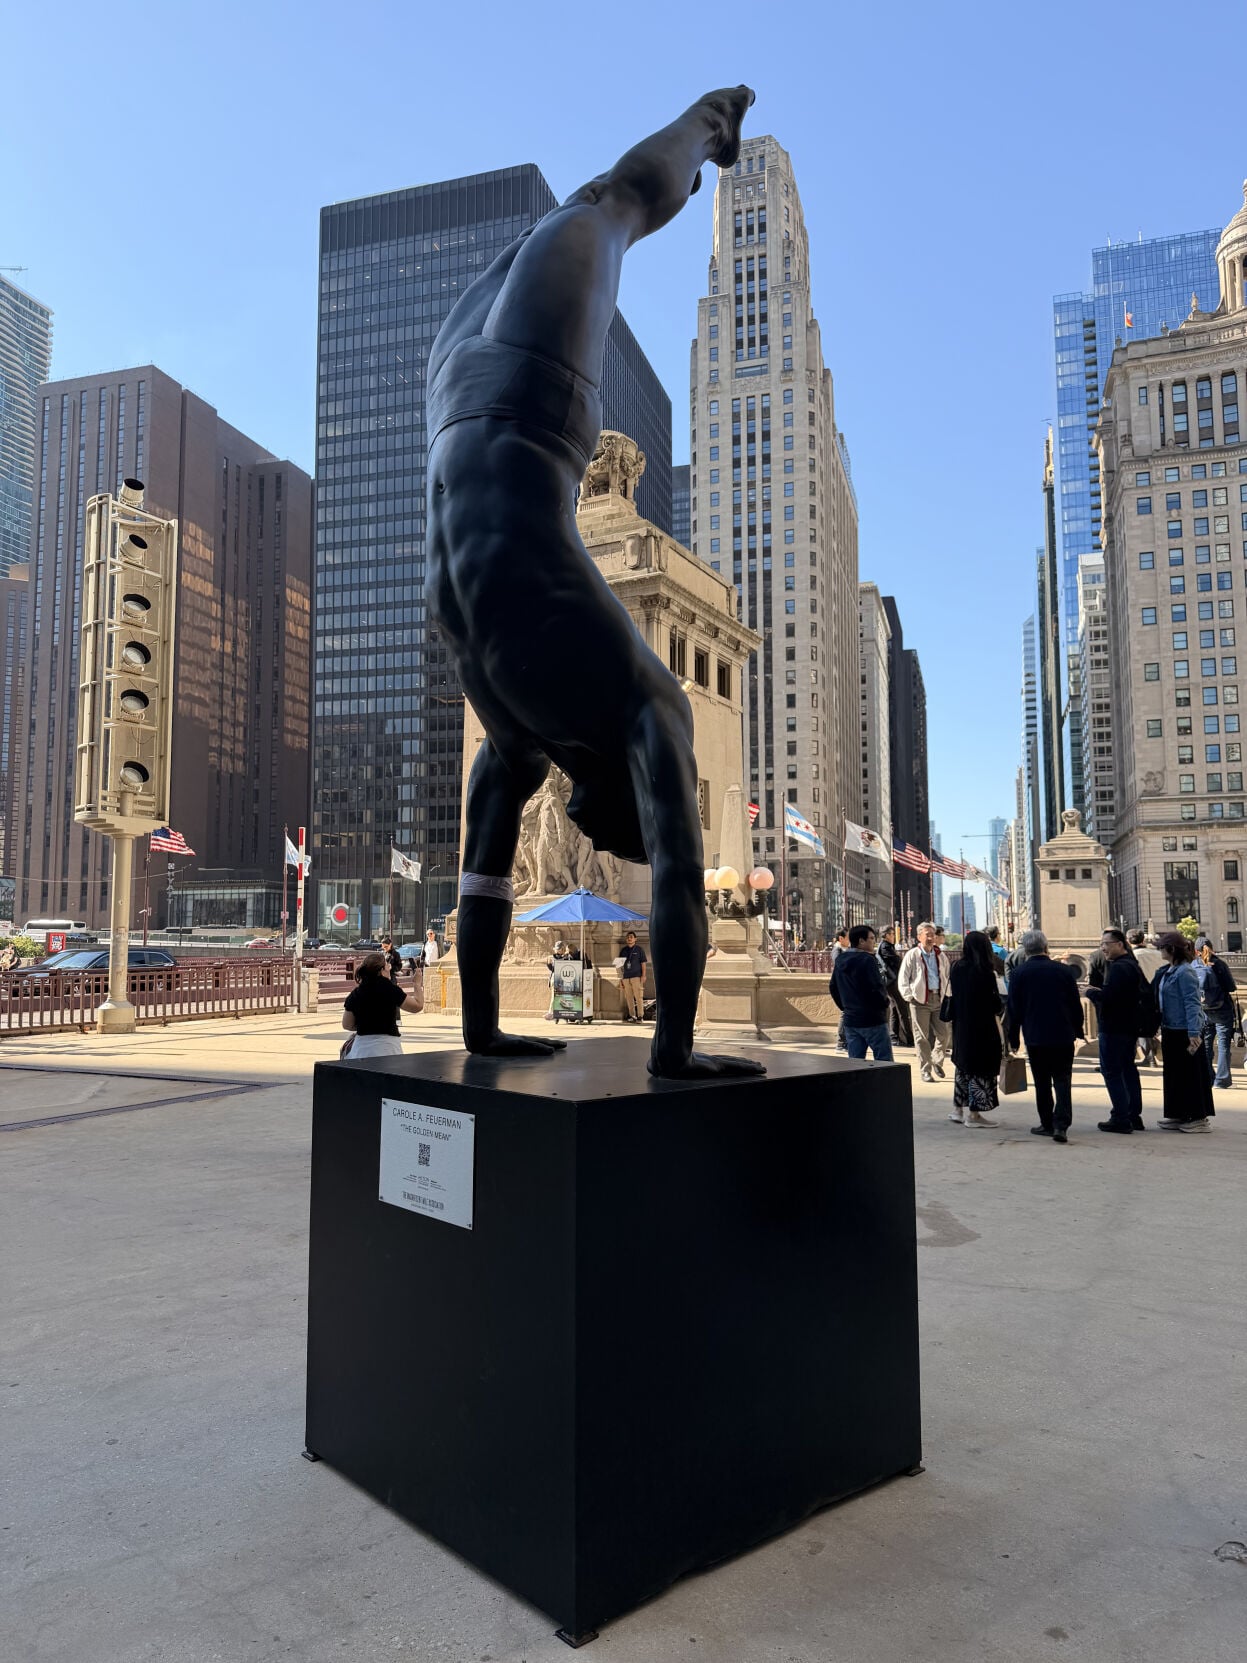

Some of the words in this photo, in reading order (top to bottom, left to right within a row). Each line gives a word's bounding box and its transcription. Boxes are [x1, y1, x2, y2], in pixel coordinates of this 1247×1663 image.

[393, 1107, 417, 1121] CAROLE
[417, 1112, 424, 1122] A.
[425, 1114, 462, 1129] FEUERMAN
[412, 1126, 434, 1138] GOLDEN
